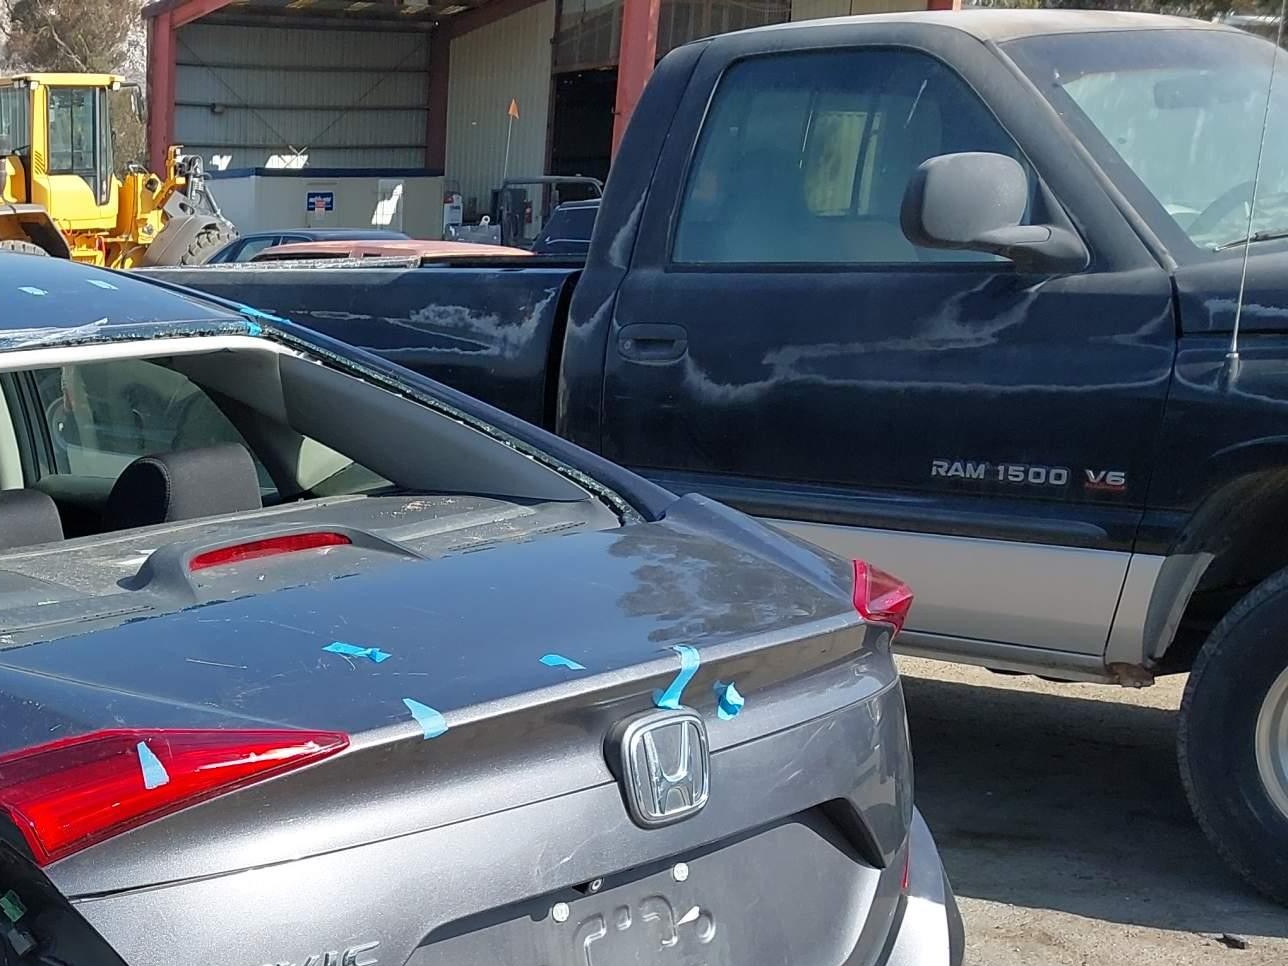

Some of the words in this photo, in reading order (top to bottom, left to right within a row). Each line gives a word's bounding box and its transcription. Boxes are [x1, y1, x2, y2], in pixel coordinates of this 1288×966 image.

[931, 460, 985, 479] RAM
[997, 464, 1069, 485] 1500
[1084, 468, 1126, 486] V6
